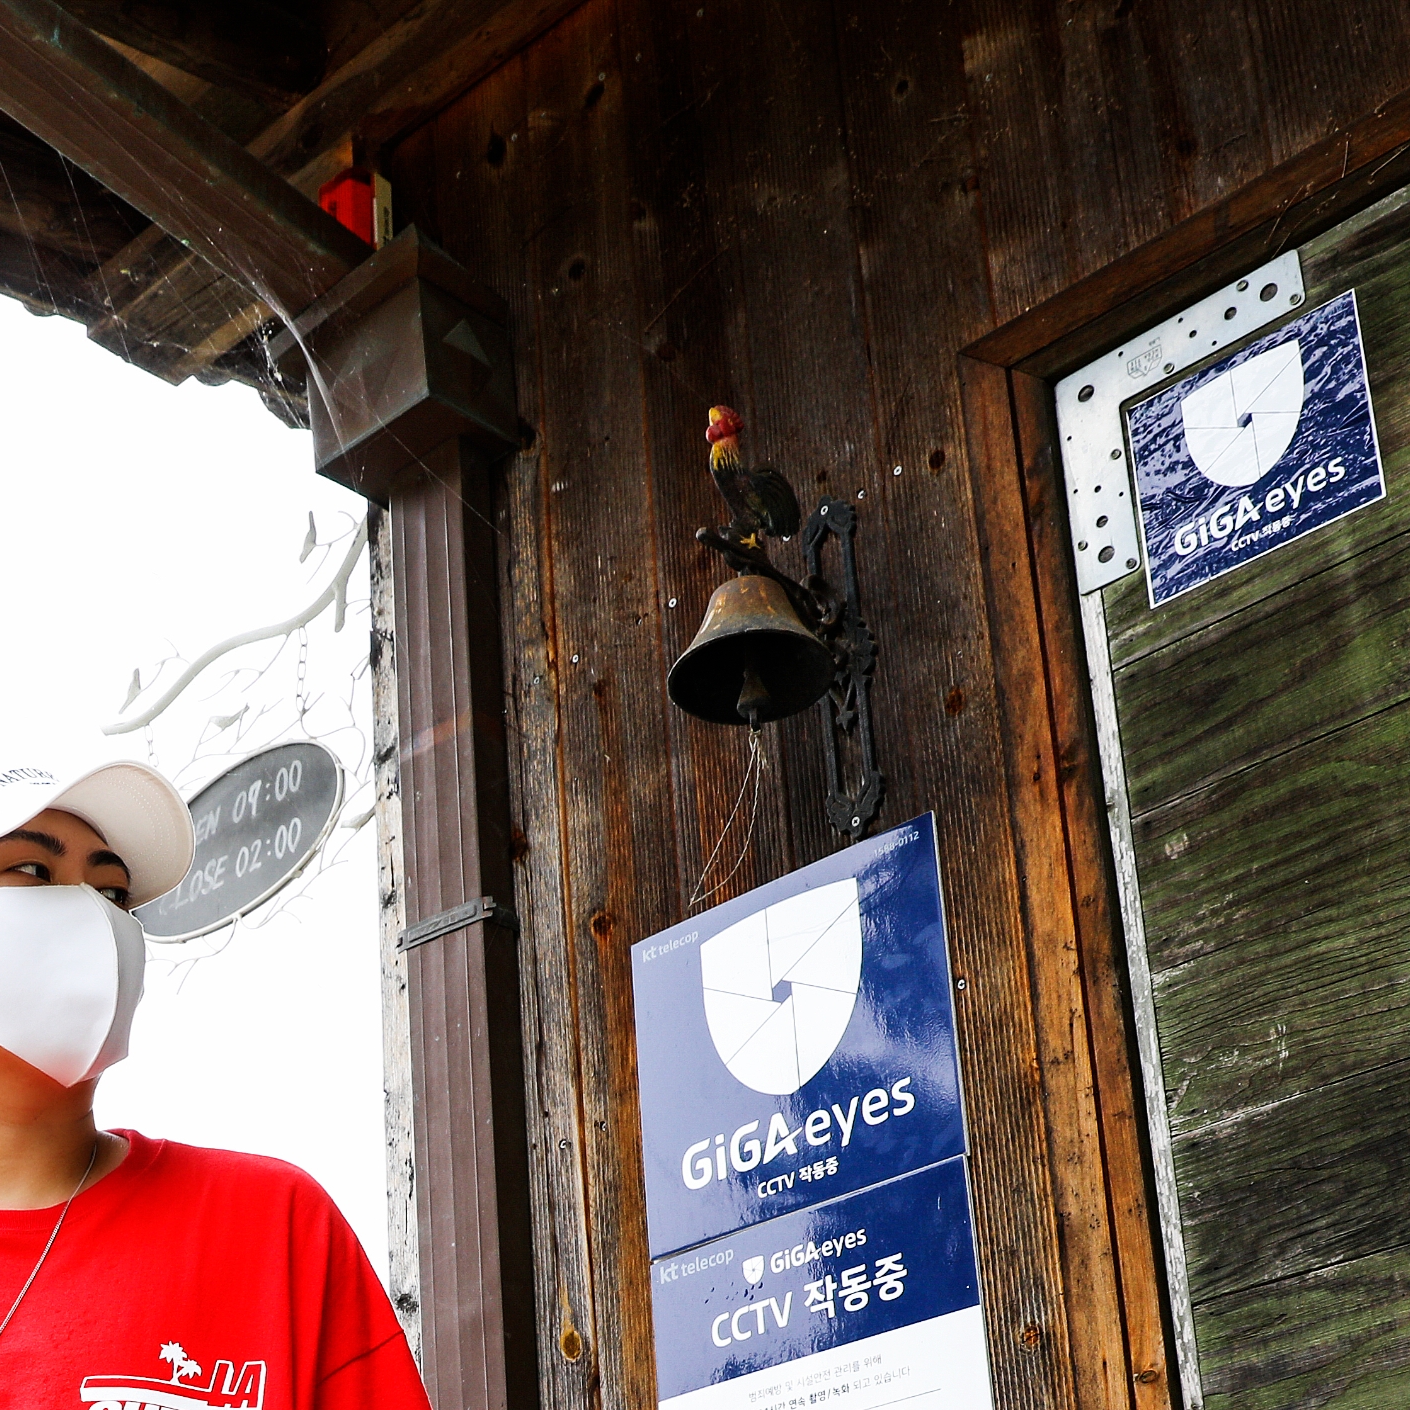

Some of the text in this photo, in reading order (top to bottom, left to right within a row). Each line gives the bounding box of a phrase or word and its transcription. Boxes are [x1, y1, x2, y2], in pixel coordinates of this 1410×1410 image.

[1231, 530, 1260, 552] CCTV
[194, 760, 302, 846] EN 09:00
[235, 817, 302, 878] 02:00
[642, 931, 699, 964] kt telecop
[757, 1155, 839, 1199] CCTV 작동중
[660, 1249, 734, 1284] kt telecop
[711, 1252, 908, 1348] CCTV 작동중
[788, 1397, 806, 1410] 연속
